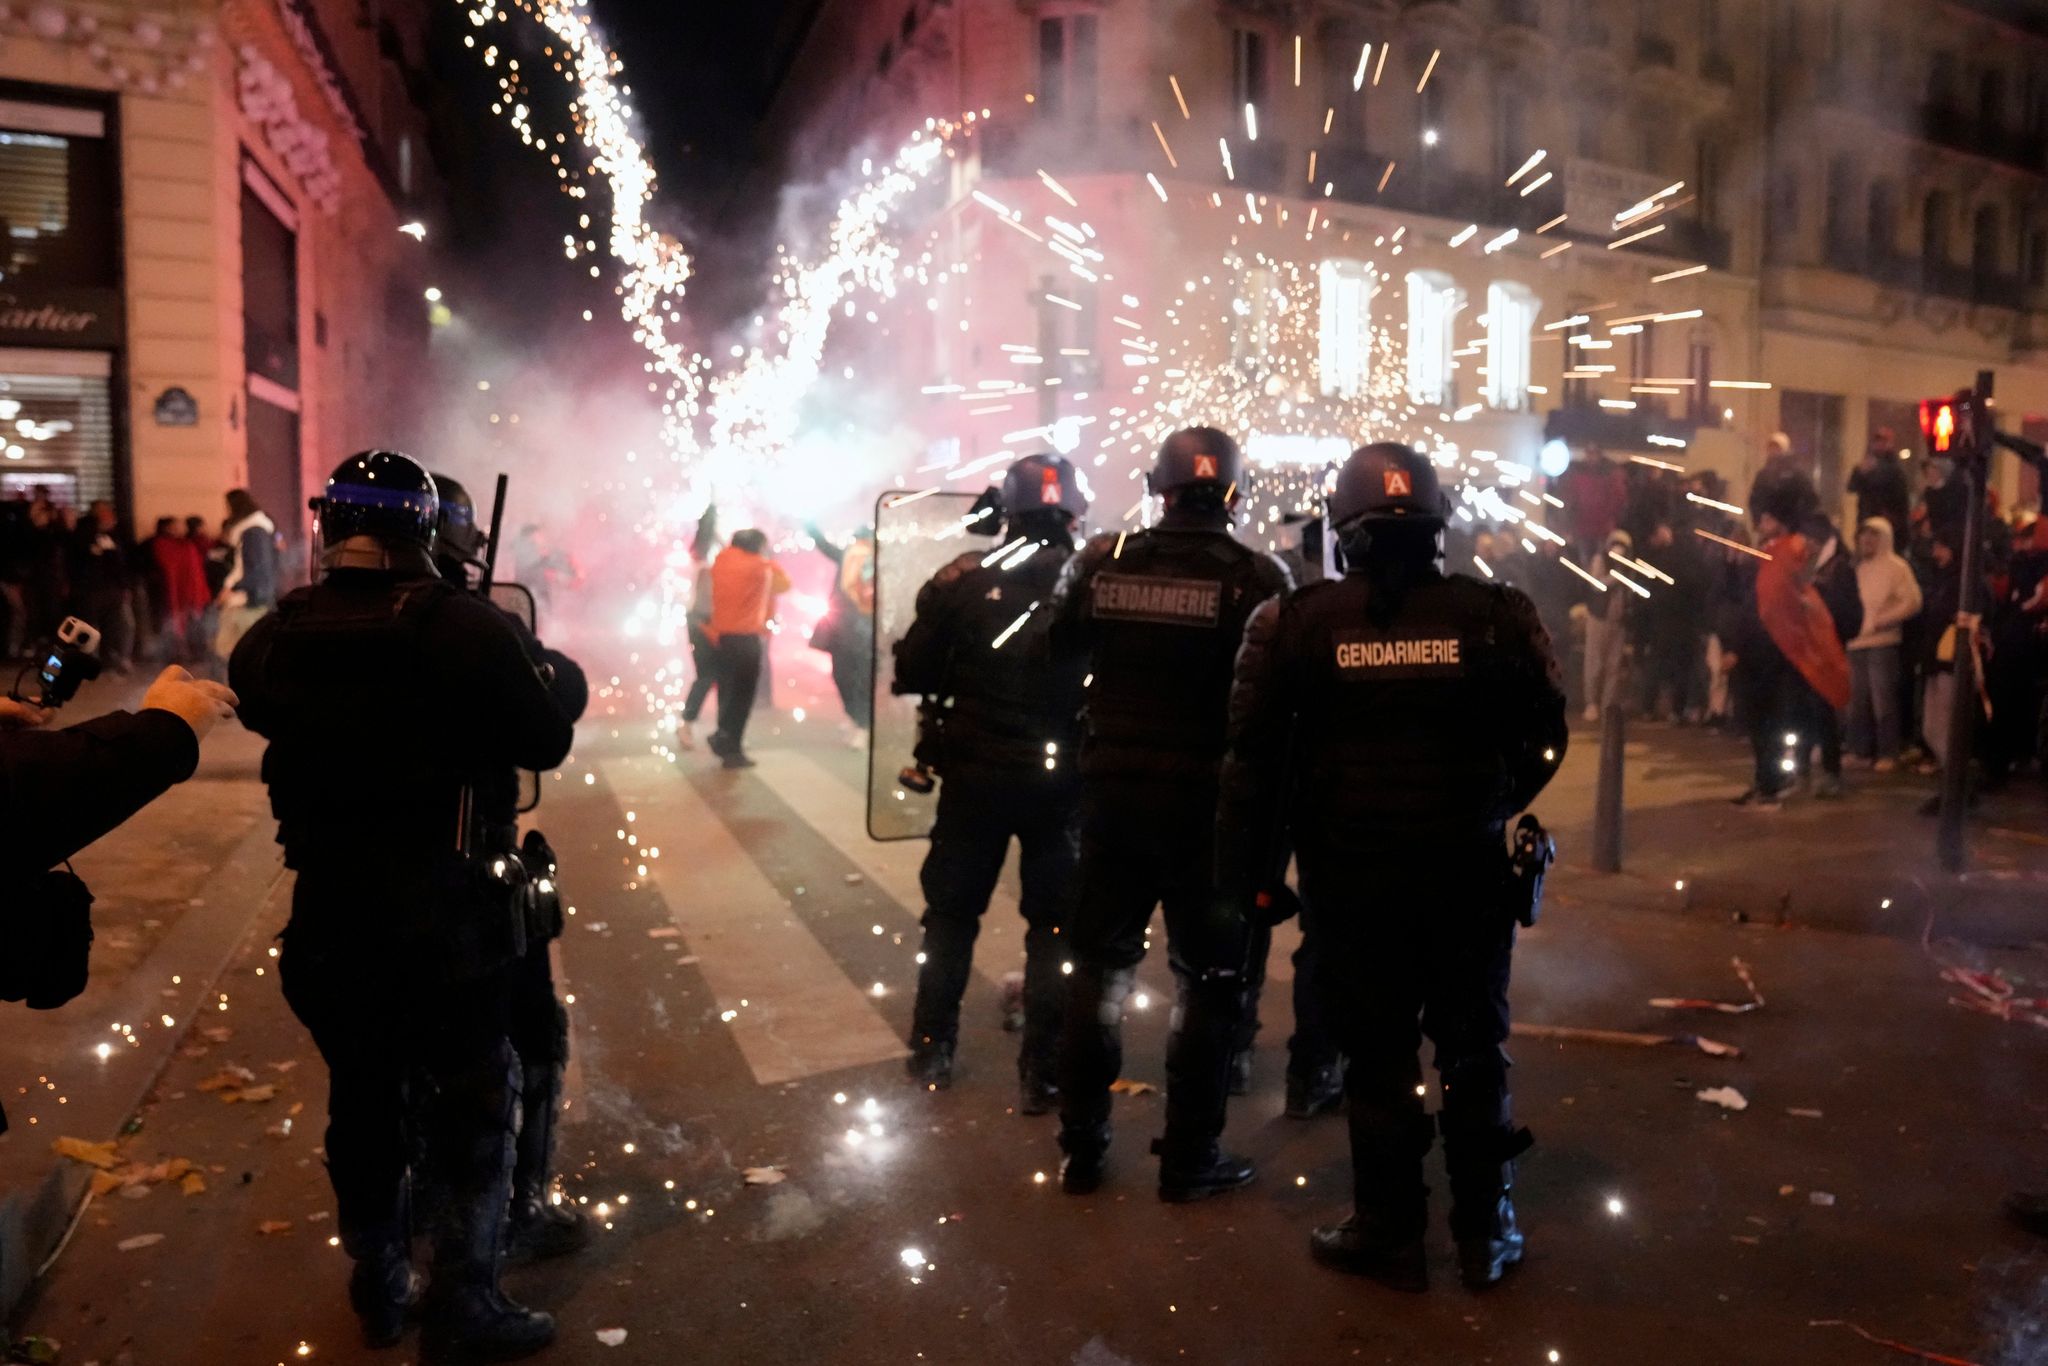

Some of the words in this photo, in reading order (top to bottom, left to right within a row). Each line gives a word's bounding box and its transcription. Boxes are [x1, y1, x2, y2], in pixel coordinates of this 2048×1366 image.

[1195, 455, 1216, 477] A
[1042, 483, 1060, 503] A
[1386, 471, 1409, 495] A
[1097, 580, 1218, 618] GENDARMERIE
[1336, 639, 1460, 668] GENDARMERIE
